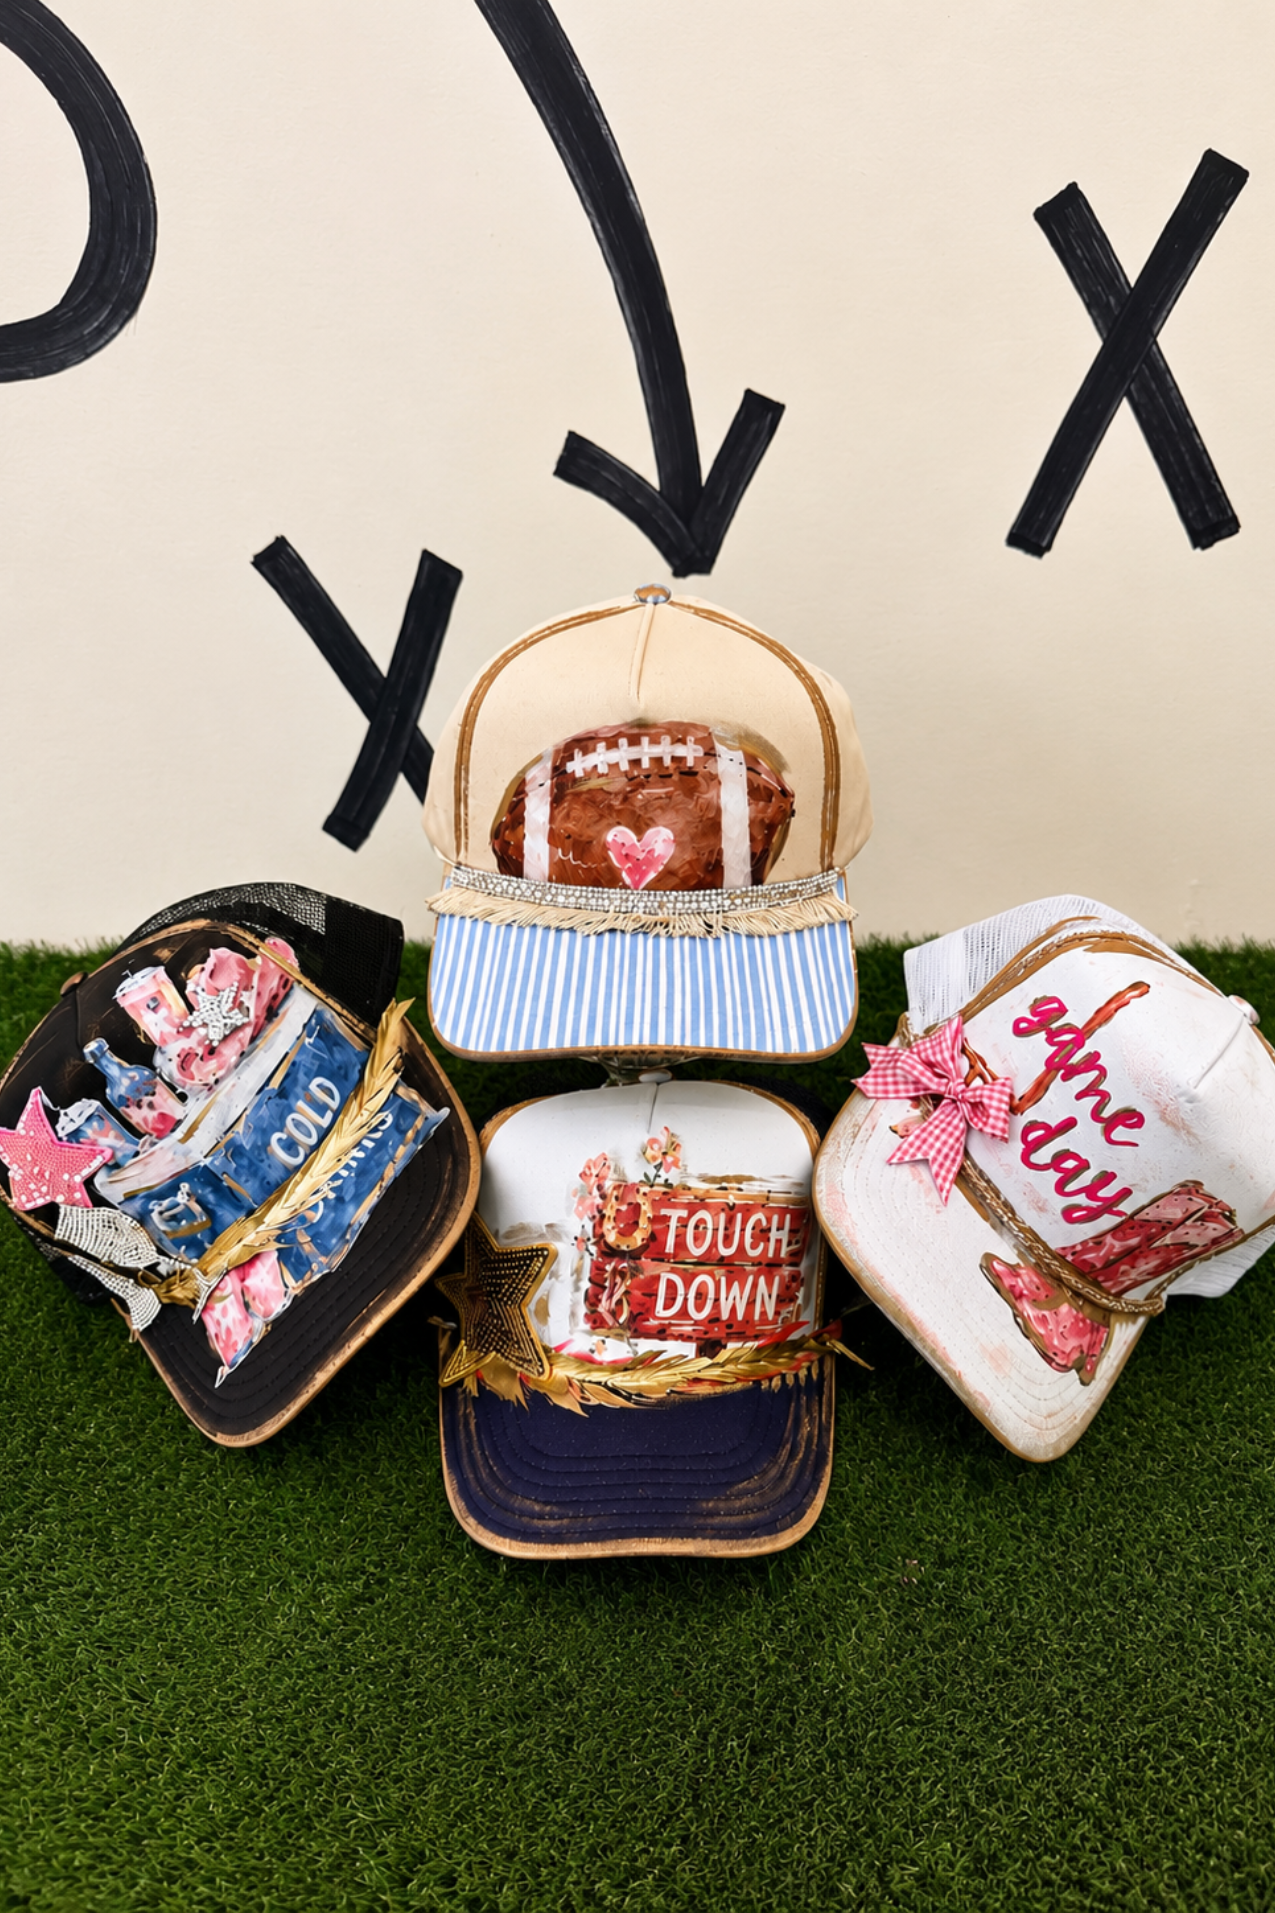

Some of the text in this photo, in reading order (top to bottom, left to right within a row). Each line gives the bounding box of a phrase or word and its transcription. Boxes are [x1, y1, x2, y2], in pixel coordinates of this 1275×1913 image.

[1012, 995, 1145, 1147] game
[270, 1076, 340, 1166] COLD
[1021, 1116, 1133, 1224] day
[660, 1208, 791, 1258] TOUCH
[655, 1272, 780, 1321] DOWN
